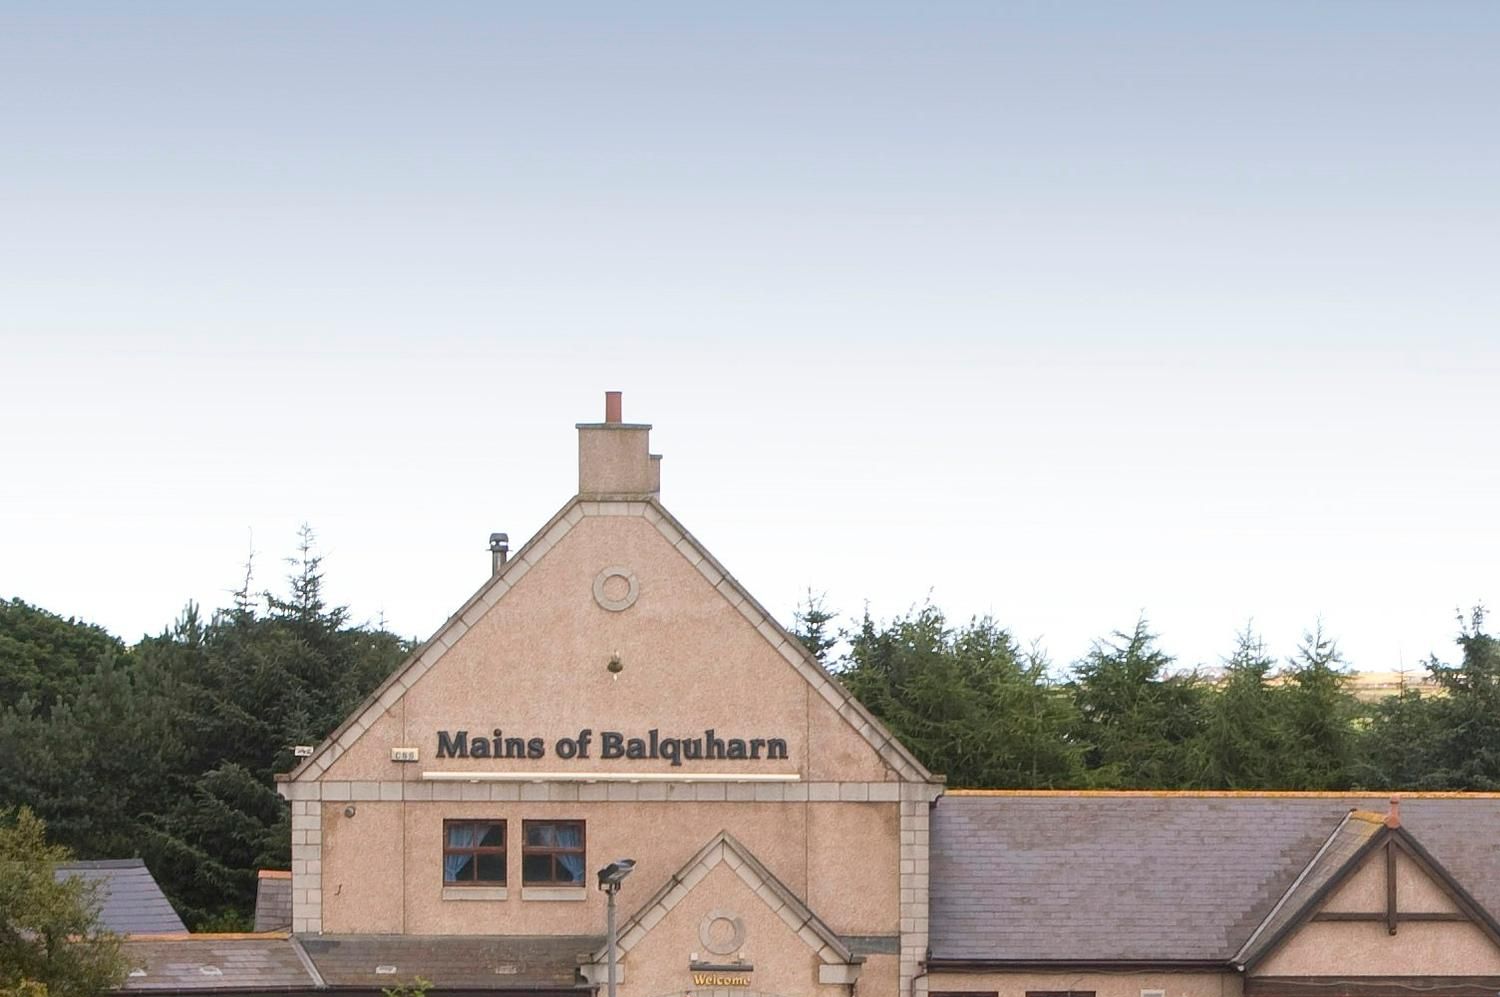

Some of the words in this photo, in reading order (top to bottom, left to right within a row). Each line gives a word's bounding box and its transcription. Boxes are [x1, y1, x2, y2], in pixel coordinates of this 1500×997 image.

[436, 728, 545, 759] Mains
[555, 729, 592, 759] of
[600, 728, 789, 766] Balquharn
[693, 974, 751, 986] Welcome
